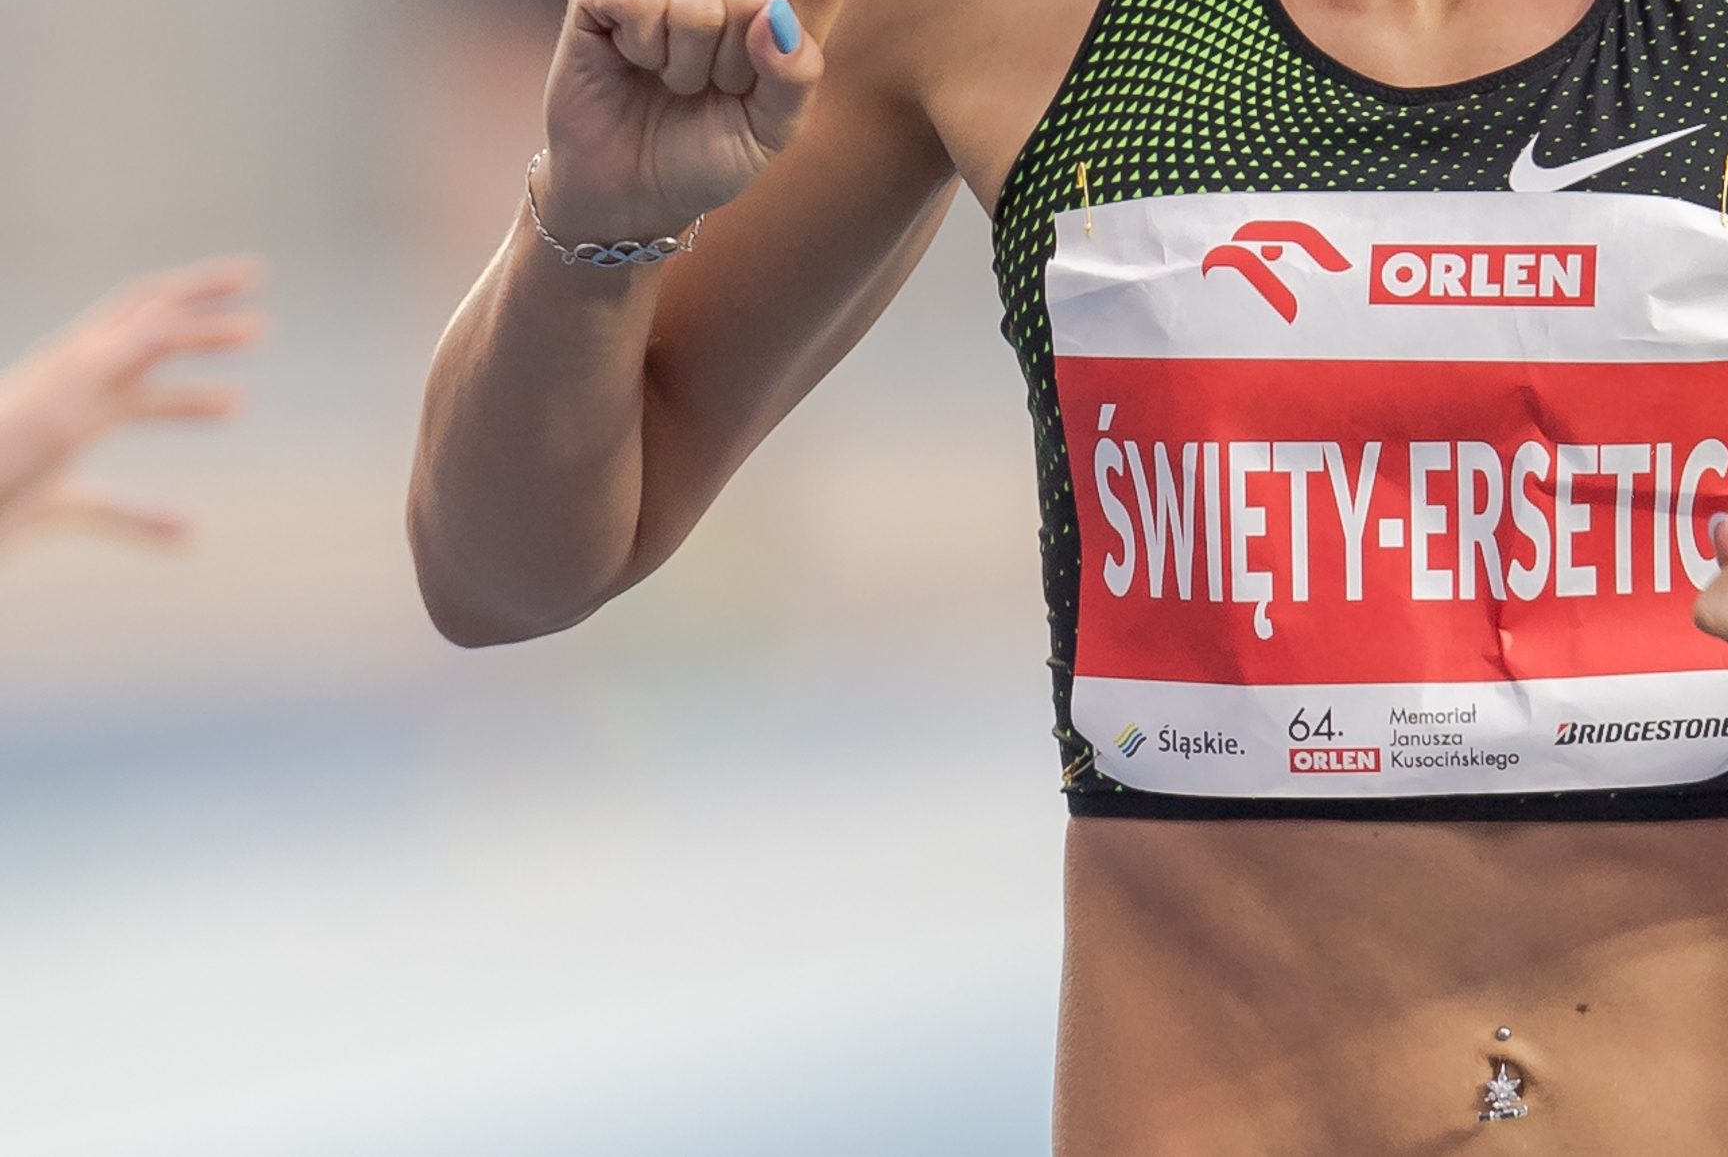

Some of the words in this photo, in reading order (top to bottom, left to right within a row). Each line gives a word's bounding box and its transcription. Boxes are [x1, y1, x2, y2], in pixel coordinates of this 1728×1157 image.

[1380, 252, 1583, 300] ORLEN
[1288, 707, 1344, 741] 64.
[1388, 703, 1477, 725] Memoriał
[1157, 724, 1246, 760] Śląskie.
[1389, 729, 1463, 747] Janusza
[1293, 751, 1376, 770] ORLEN
[1390, 748, 1520, 771] Kusocińskiego
